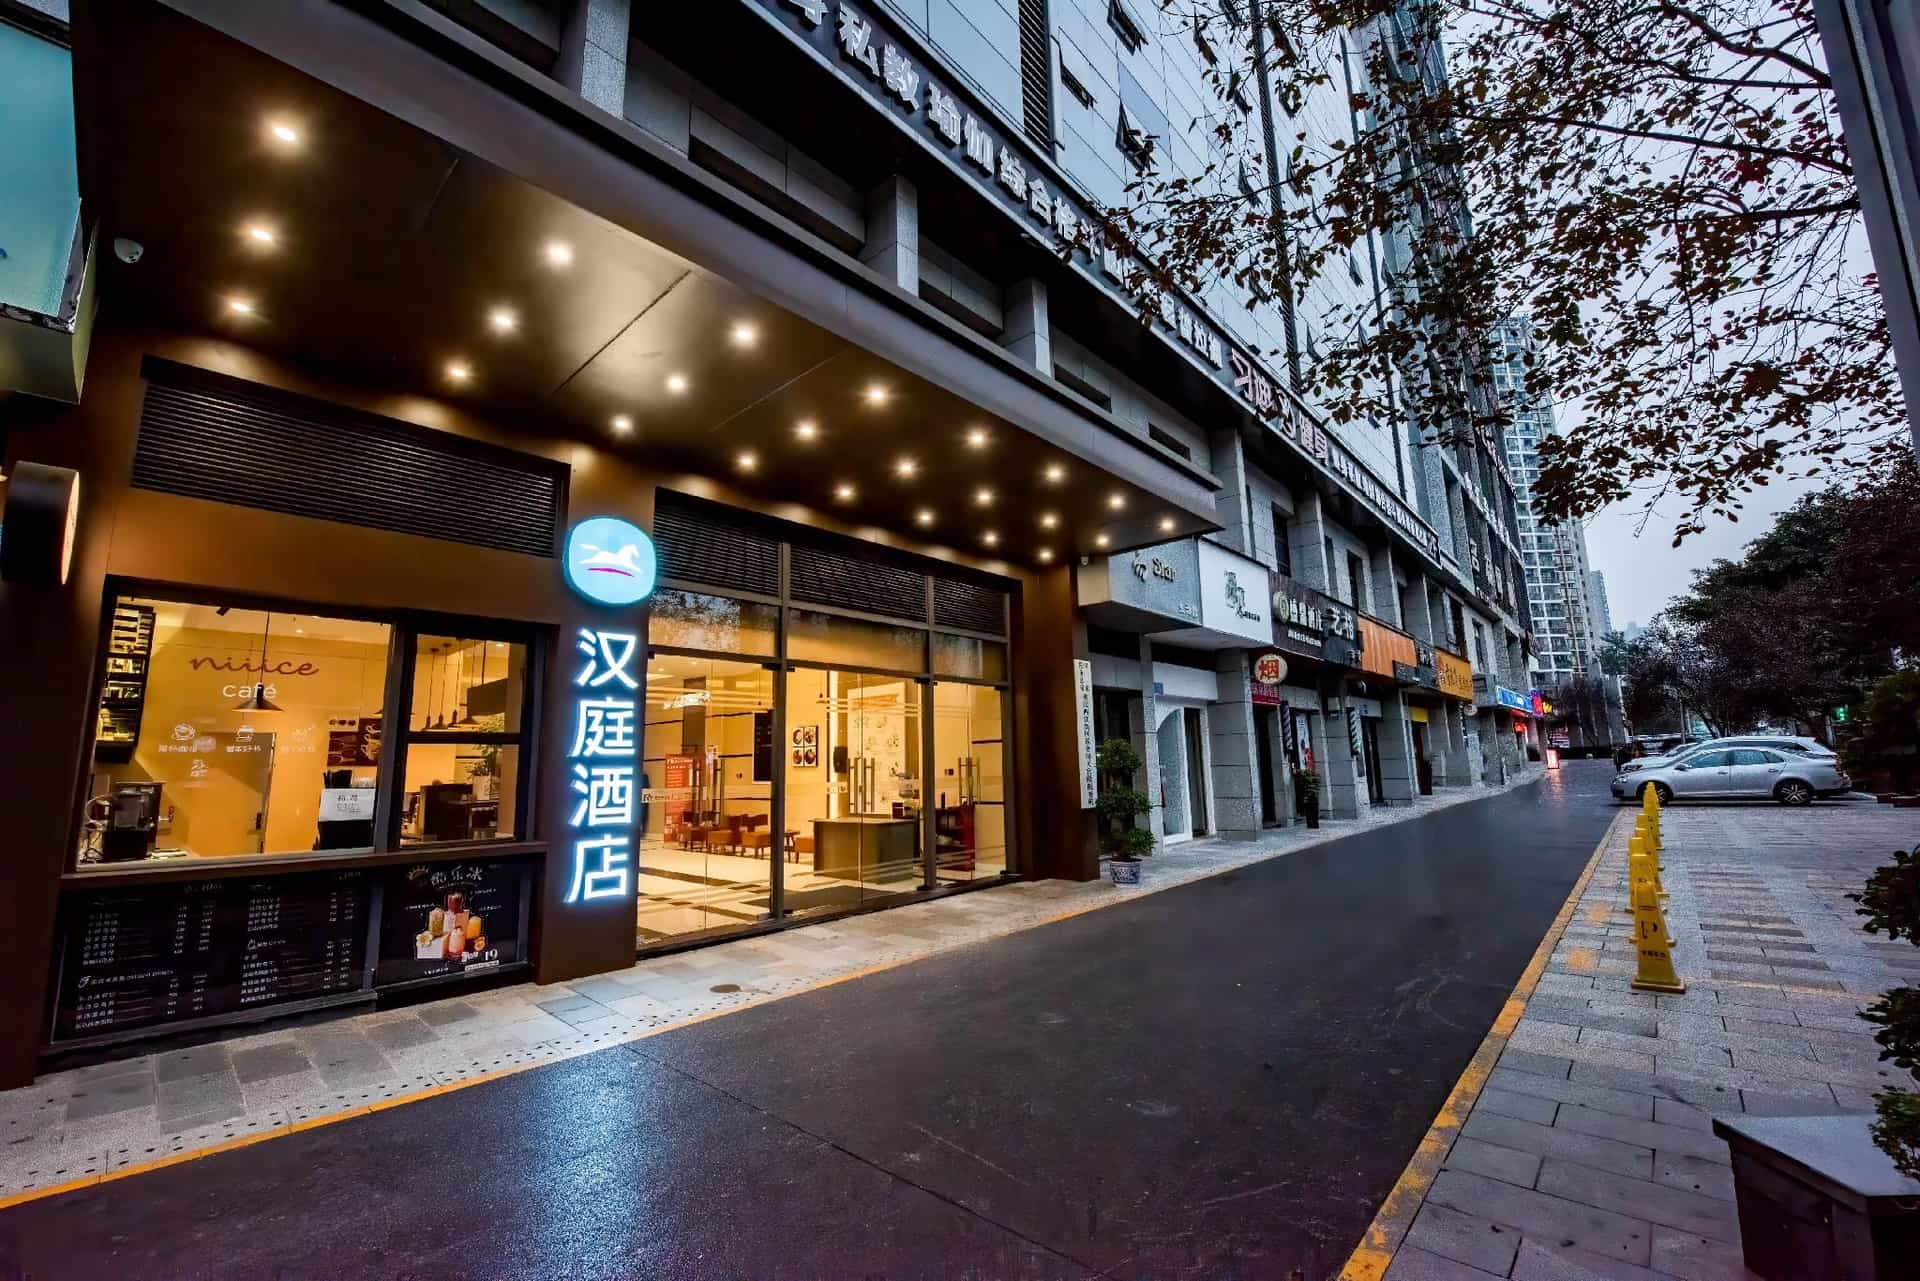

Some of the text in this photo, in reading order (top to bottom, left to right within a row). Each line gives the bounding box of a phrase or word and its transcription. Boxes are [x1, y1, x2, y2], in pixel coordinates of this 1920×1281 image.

[189, 655, 320, 677] niiice
[1259, 659, 1280, 680] 烟
[222, 682, 278, 699] café
[564, 627, 639, 904] 汉庭酒店
